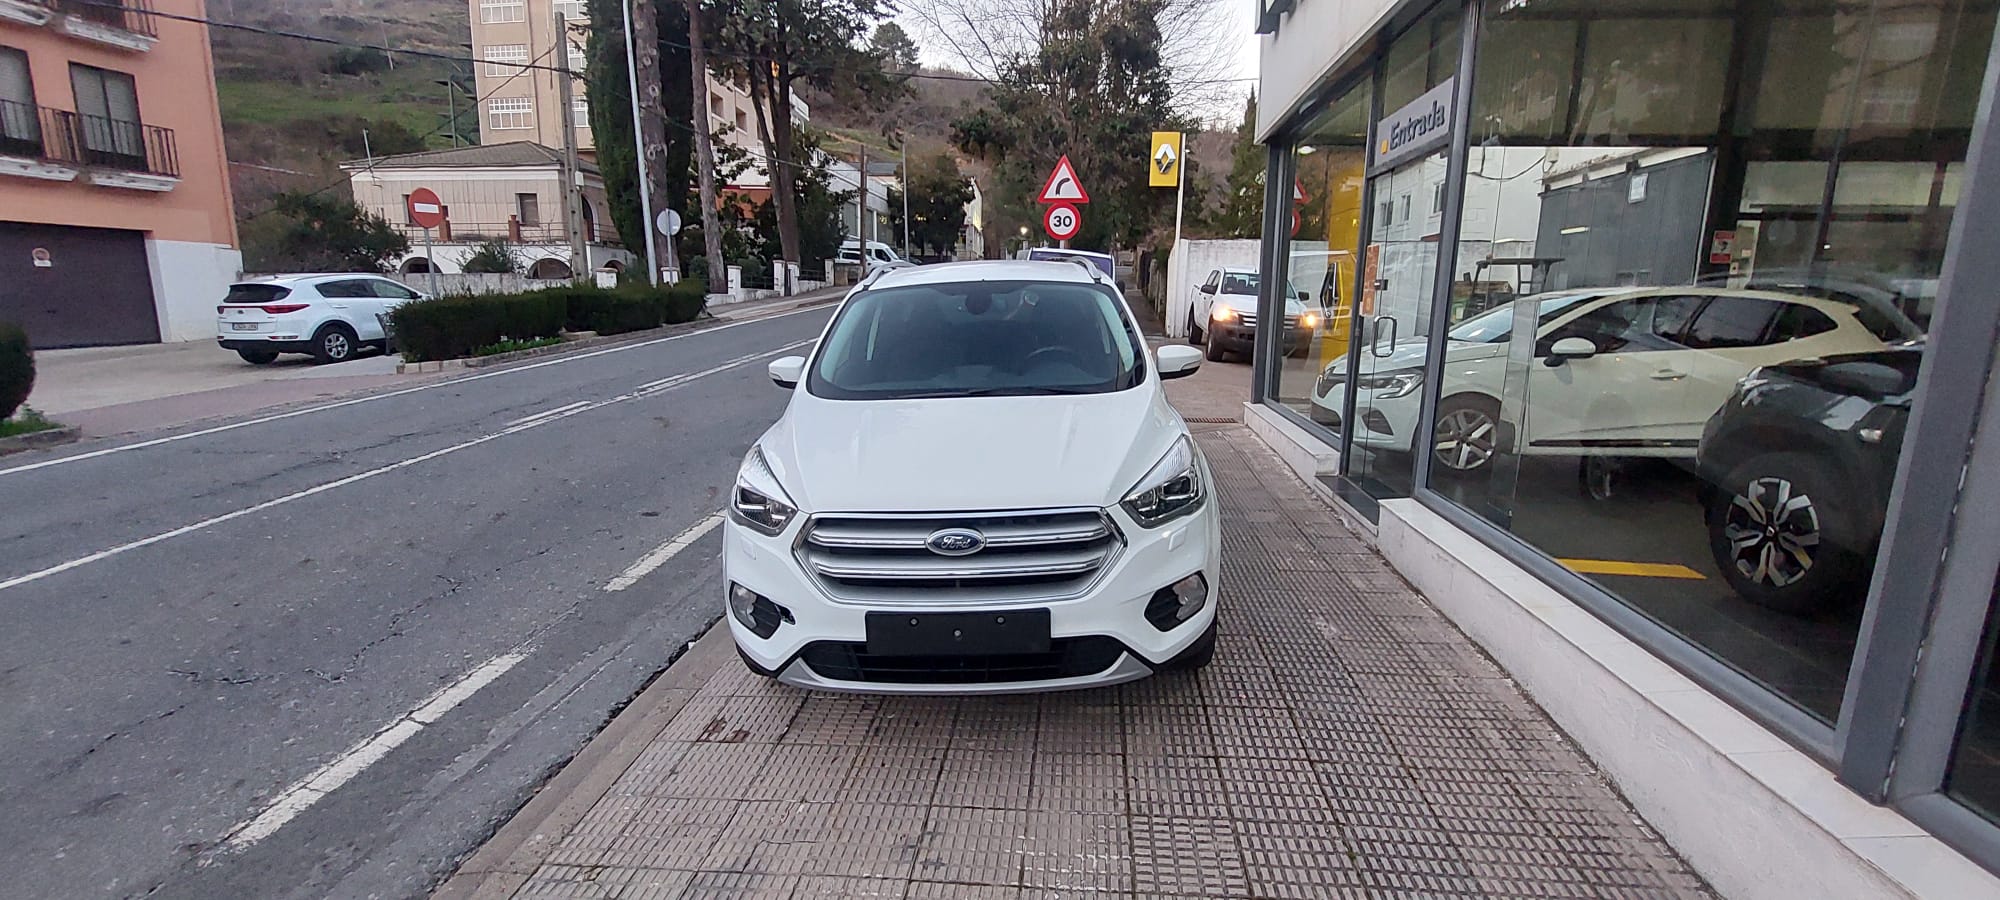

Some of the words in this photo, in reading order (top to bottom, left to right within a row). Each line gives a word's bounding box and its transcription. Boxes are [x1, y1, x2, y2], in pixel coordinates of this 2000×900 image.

[1390, 100, 1445, 151] Entrada
[1053, 215, 1073, 228] 30
[941, 535, 971, 549] Ford
